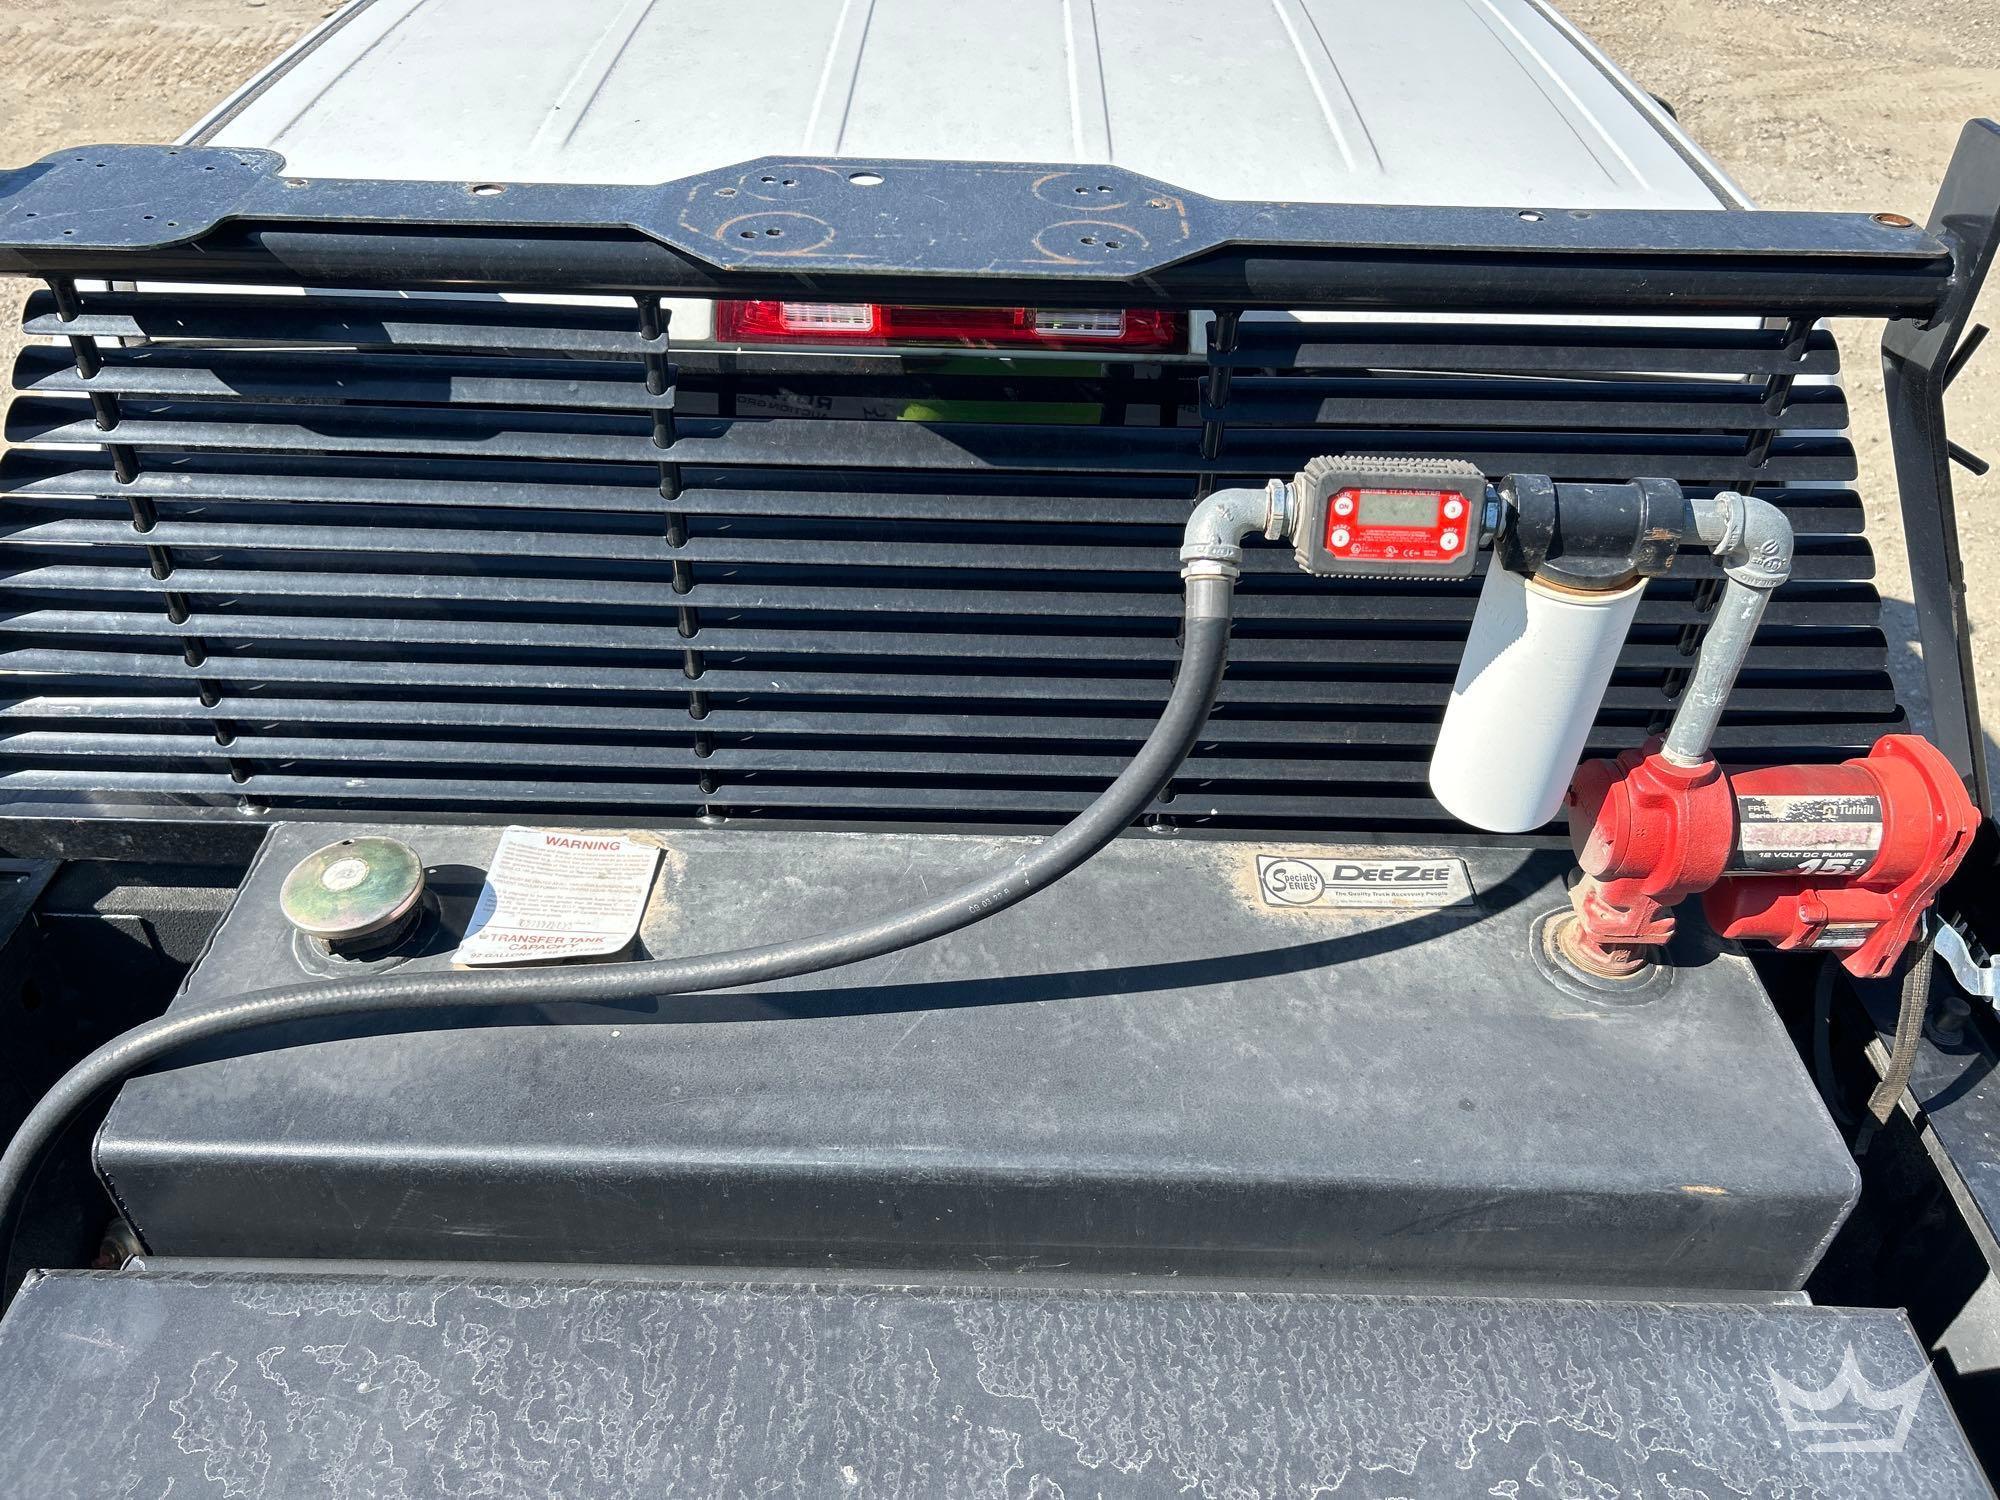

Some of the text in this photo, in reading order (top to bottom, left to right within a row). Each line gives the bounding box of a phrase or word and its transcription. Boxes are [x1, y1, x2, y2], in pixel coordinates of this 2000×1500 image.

[1840, 804, 1874, 816] Tuthill
[546, 836, 621, 851] WARNING
[1797, 858, 1851, 875] 15
[490, 934, 565, 944] TRANSFER
